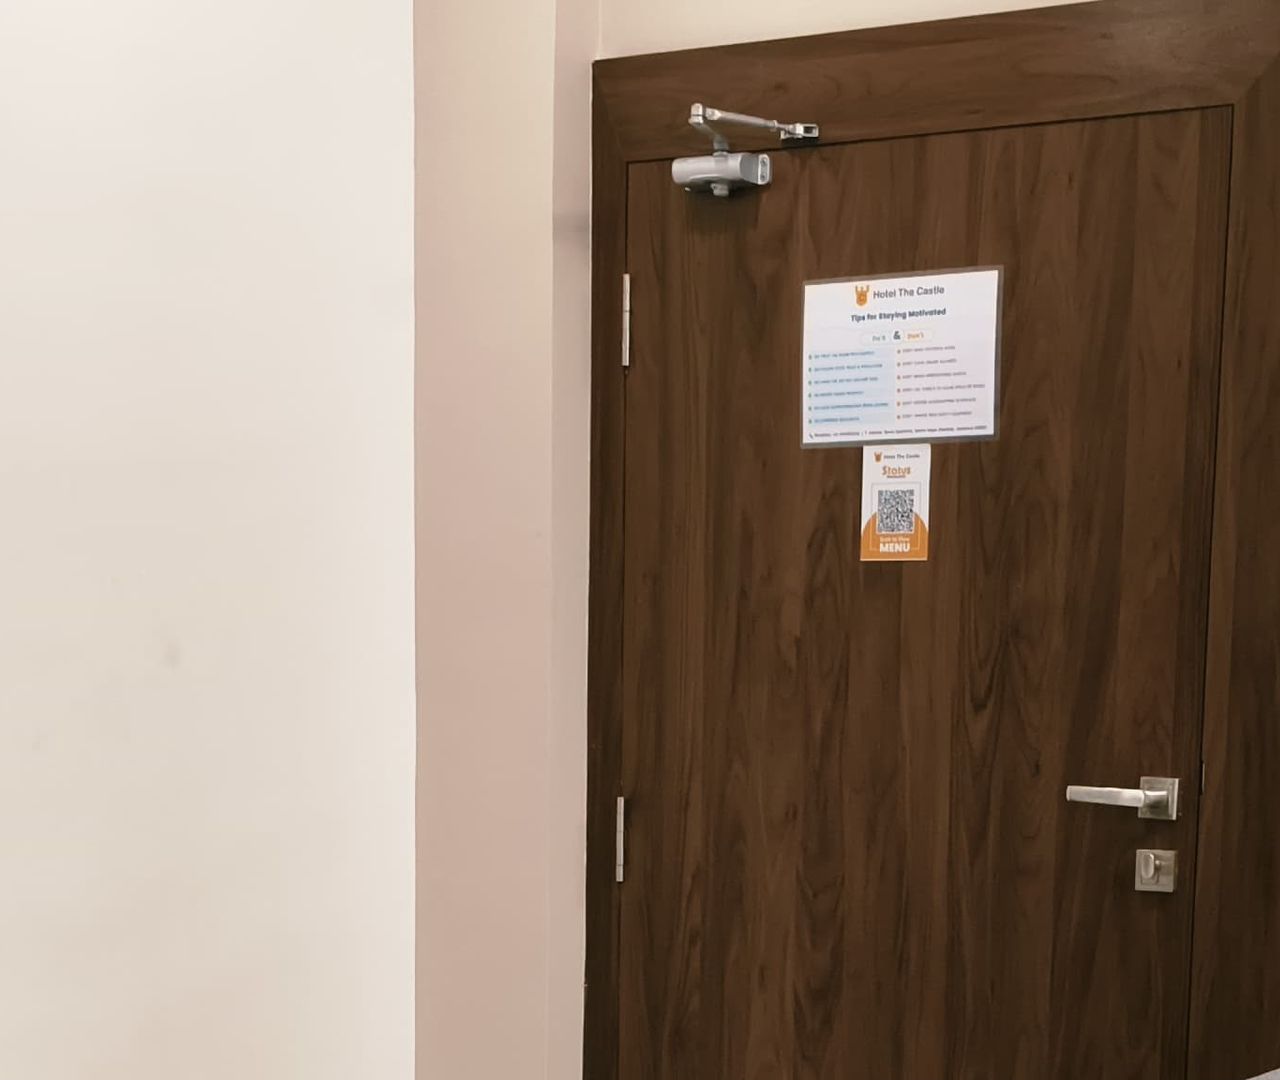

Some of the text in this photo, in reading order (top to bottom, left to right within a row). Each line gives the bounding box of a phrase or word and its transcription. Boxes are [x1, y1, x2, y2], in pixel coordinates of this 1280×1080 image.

[873, 285, 945, 300] Hotel The Castle
[851, 308, 946, 323] Tips for Staying Motivated
[893, 331, 901, 340] &
[879, 543, 910, 553] MENU
